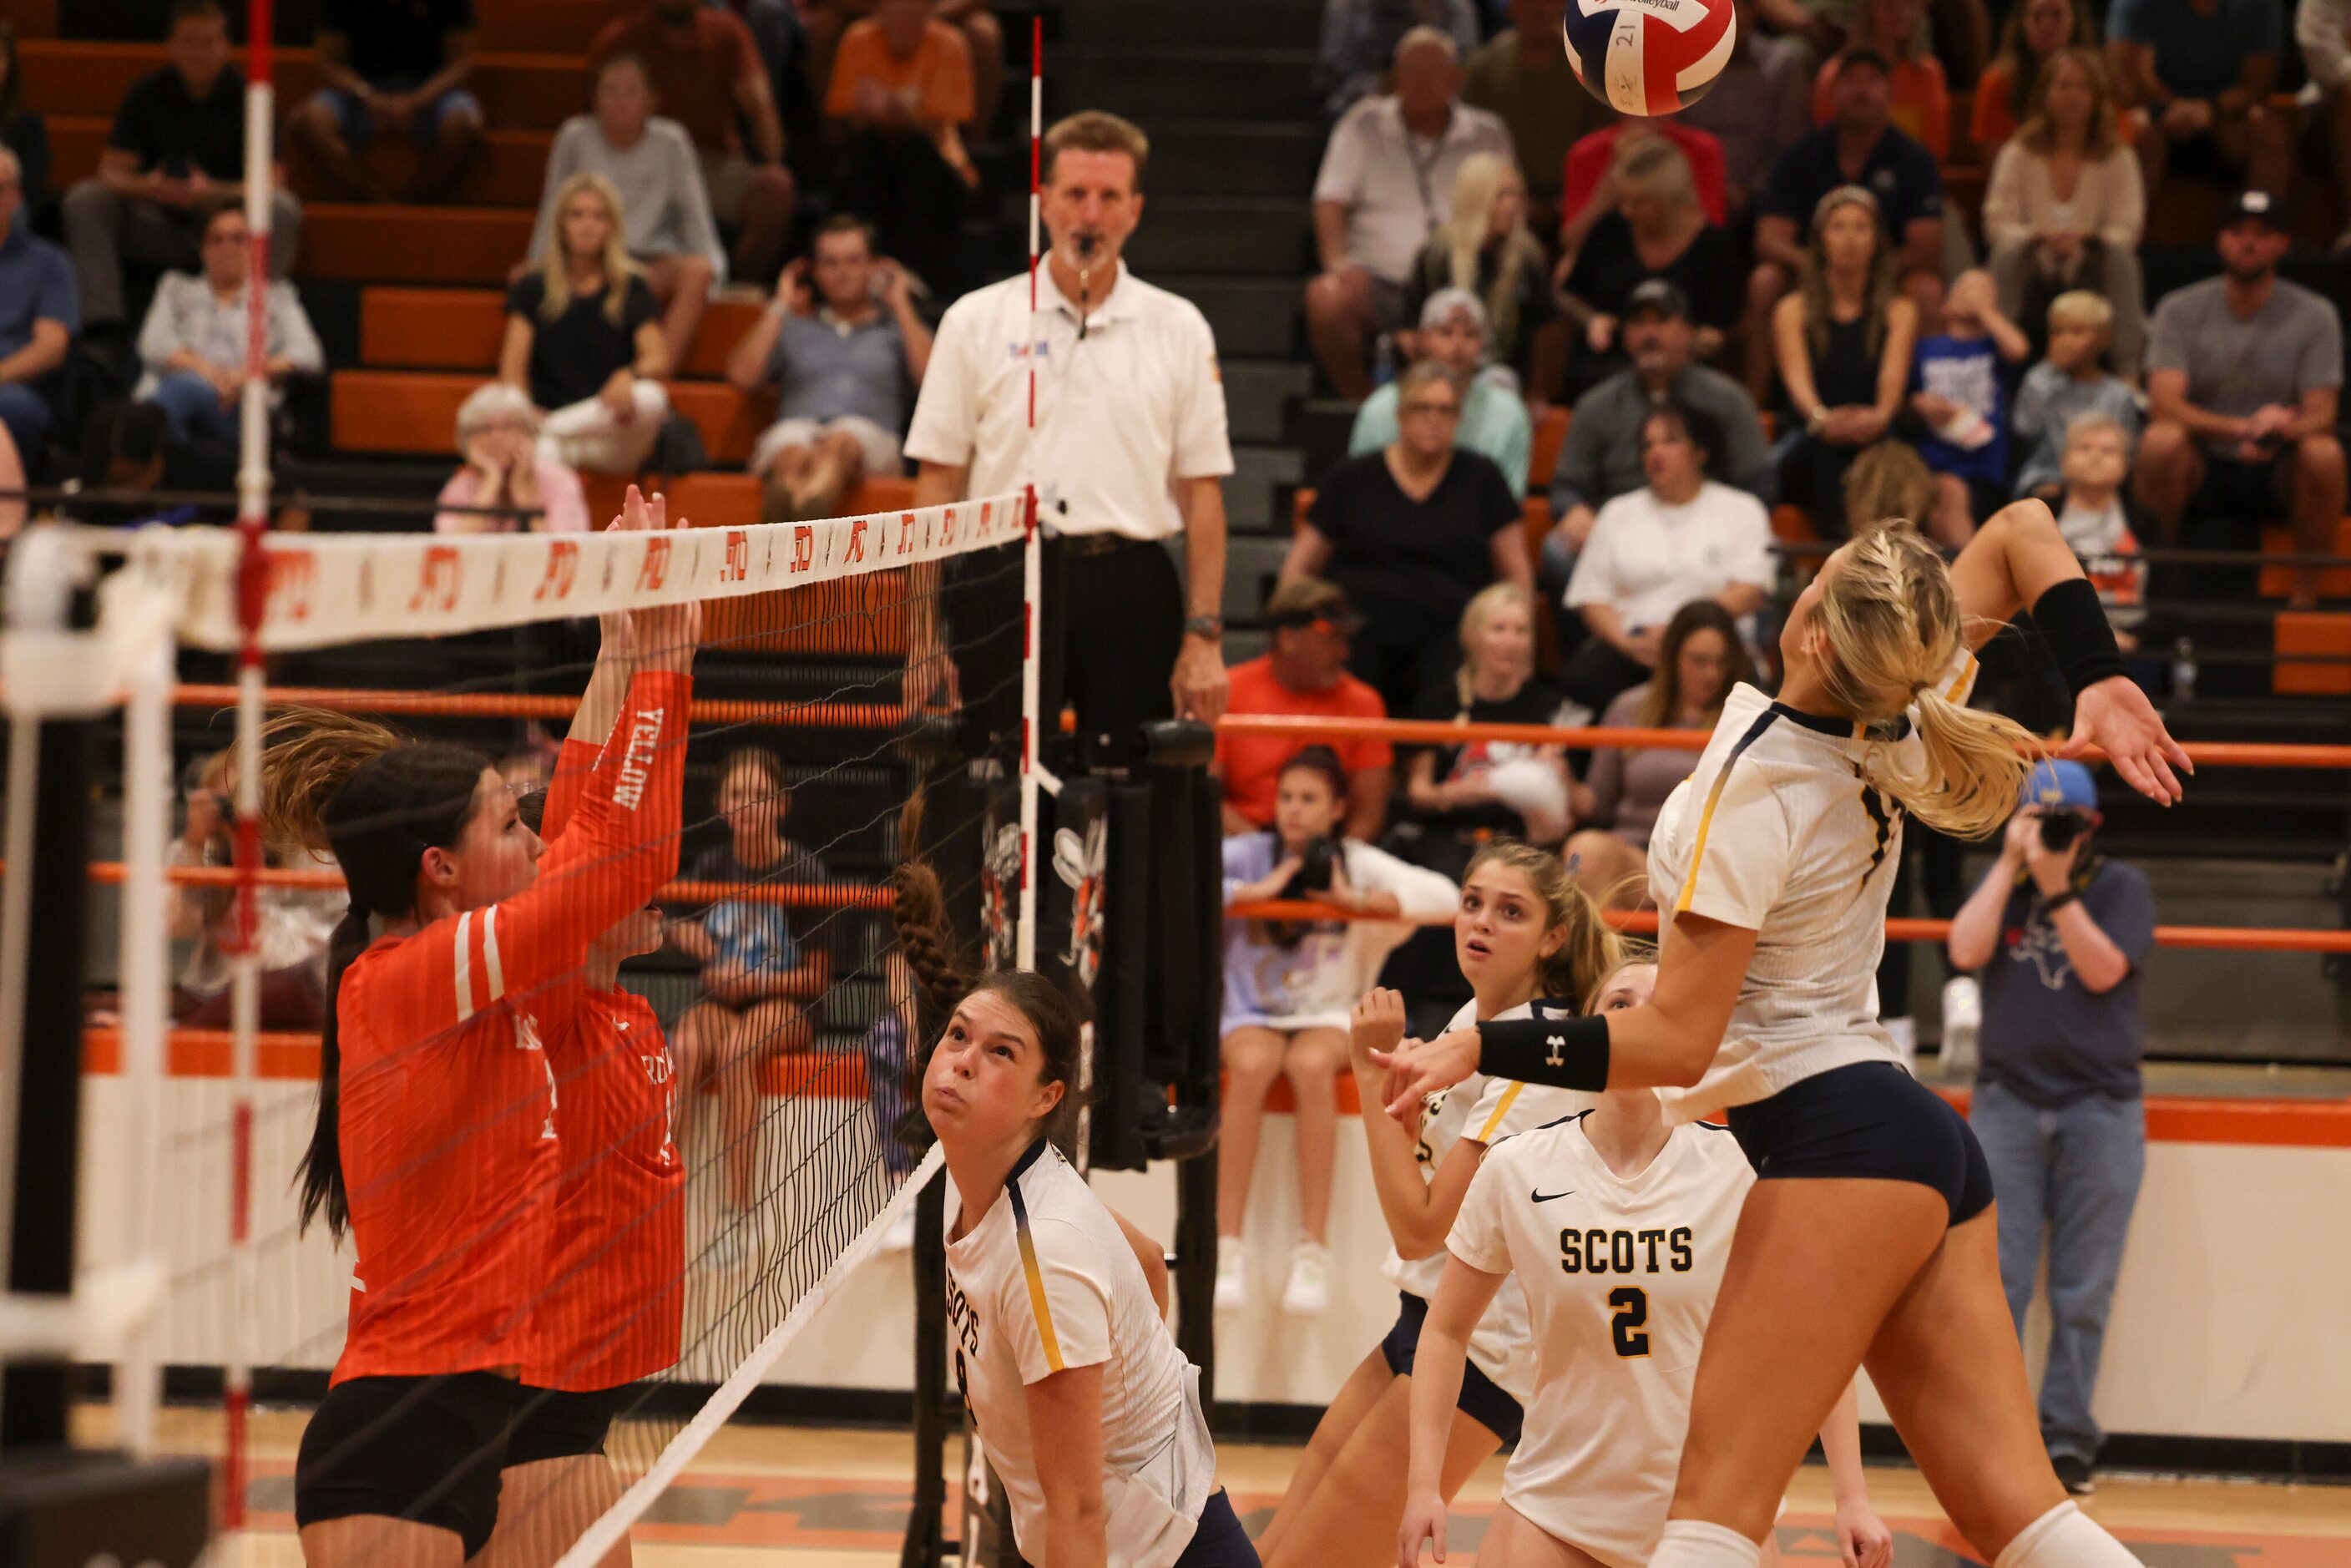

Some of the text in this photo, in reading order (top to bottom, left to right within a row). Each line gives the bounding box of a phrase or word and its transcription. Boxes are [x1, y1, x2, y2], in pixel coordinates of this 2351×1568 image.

[1615, 25, 1636, 48] 21
[612, 707, 665, 812] YELLOW
[1560, 1226, 1693, 1274] SCOTS
[1606, 1284, 1652, 1360] 2
